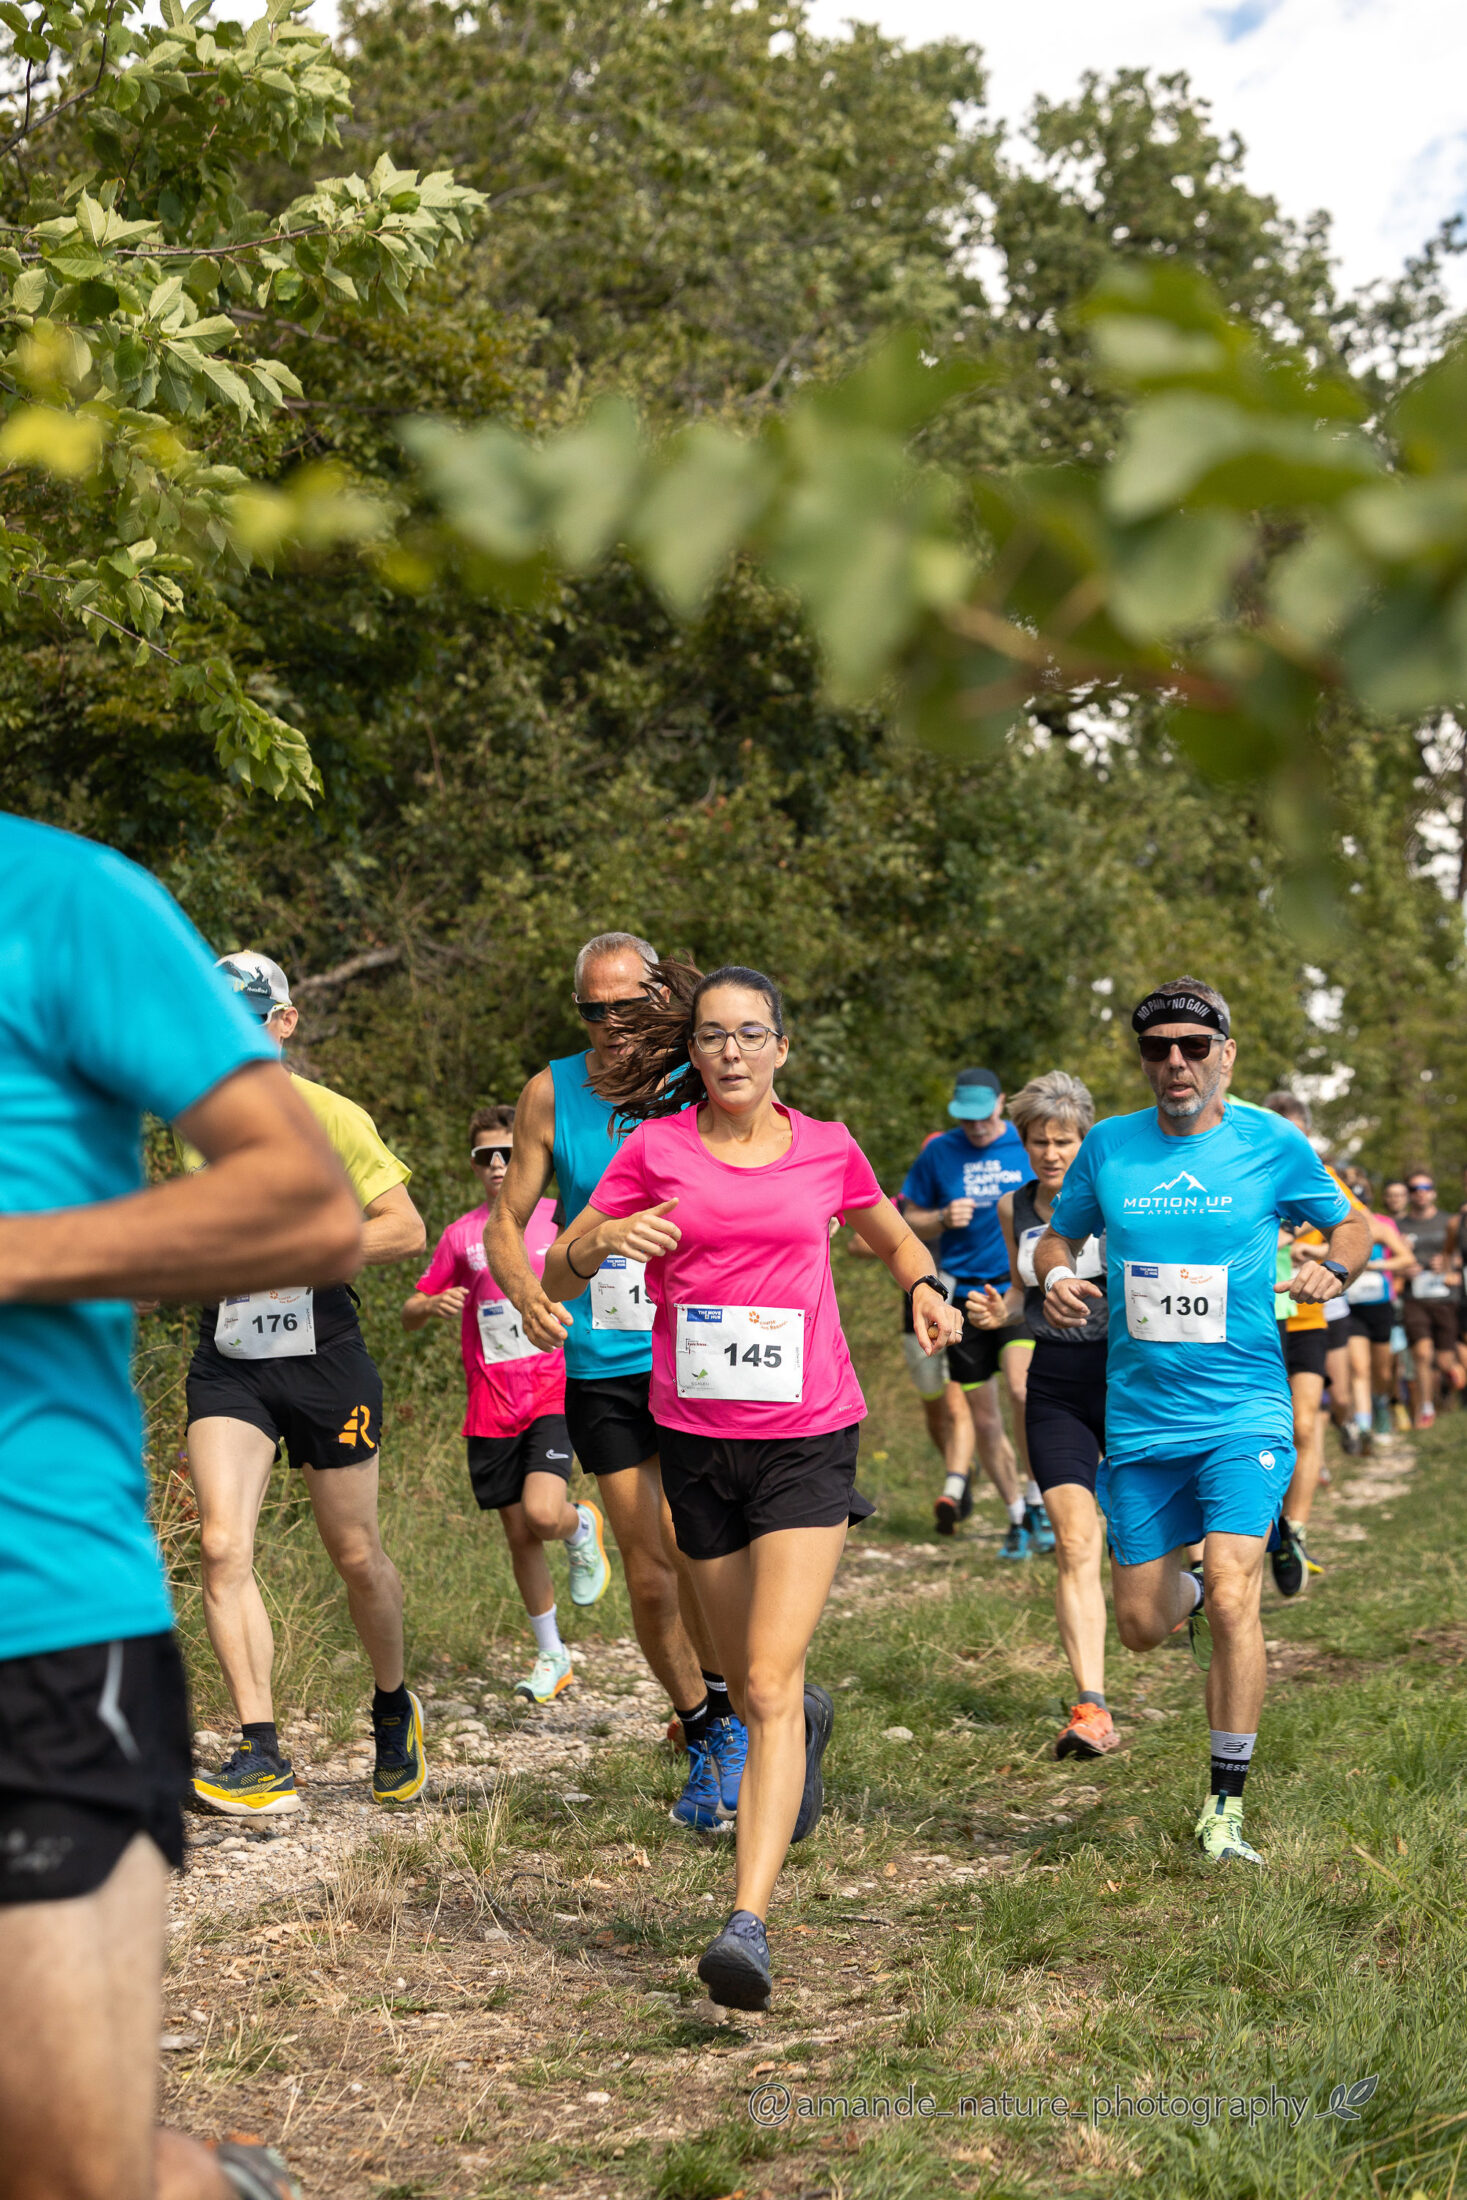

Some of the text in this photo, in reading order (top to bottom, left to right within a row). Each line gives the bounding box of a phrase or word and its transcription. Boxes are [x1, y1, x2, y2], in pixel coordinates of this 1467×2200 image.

[1137, 997, 1211, 1021] NO PAIN NO GAIN
[1123, 1196, 1233, 1208] MOTION UP
[1160, 1295, 1209, 1316] 130
[252, 1312, 298, 1334] 176
[724, 1342, 782, 1369] 145
